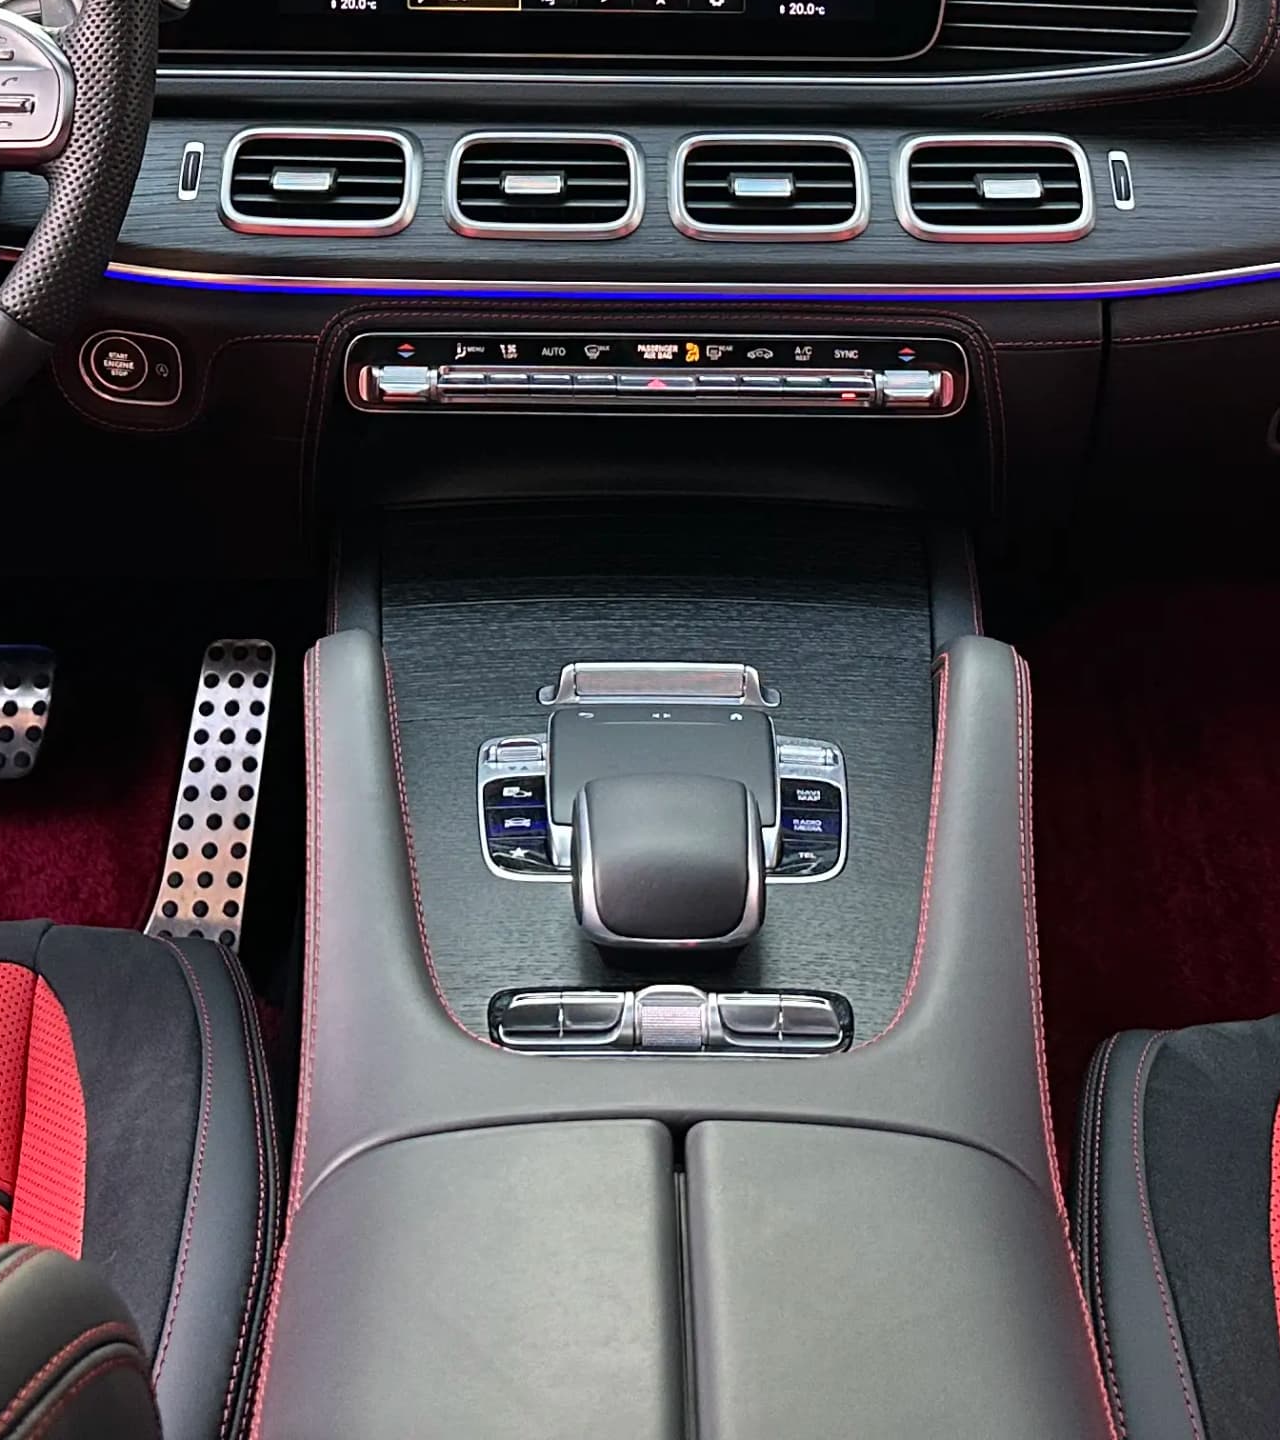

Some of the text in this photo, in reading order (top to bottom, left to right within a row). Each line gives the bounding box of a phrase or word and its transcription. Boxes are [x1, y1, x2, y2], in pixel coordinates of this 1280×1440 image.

[541, 346, 566, 357] AUTO
[637, 344, 679, 353] PASSENGER
[794, 345, 813, 356] A/C
[108, 351, 129, 360] START
[643, 351, 673, 360] AIR BAG
[833, 348, 859, 360] SYNC
[103, 359, 135, 370] ENGINE
[792, 818, 823, 826] RADIO
[798, 851, 817, 860] TEL
